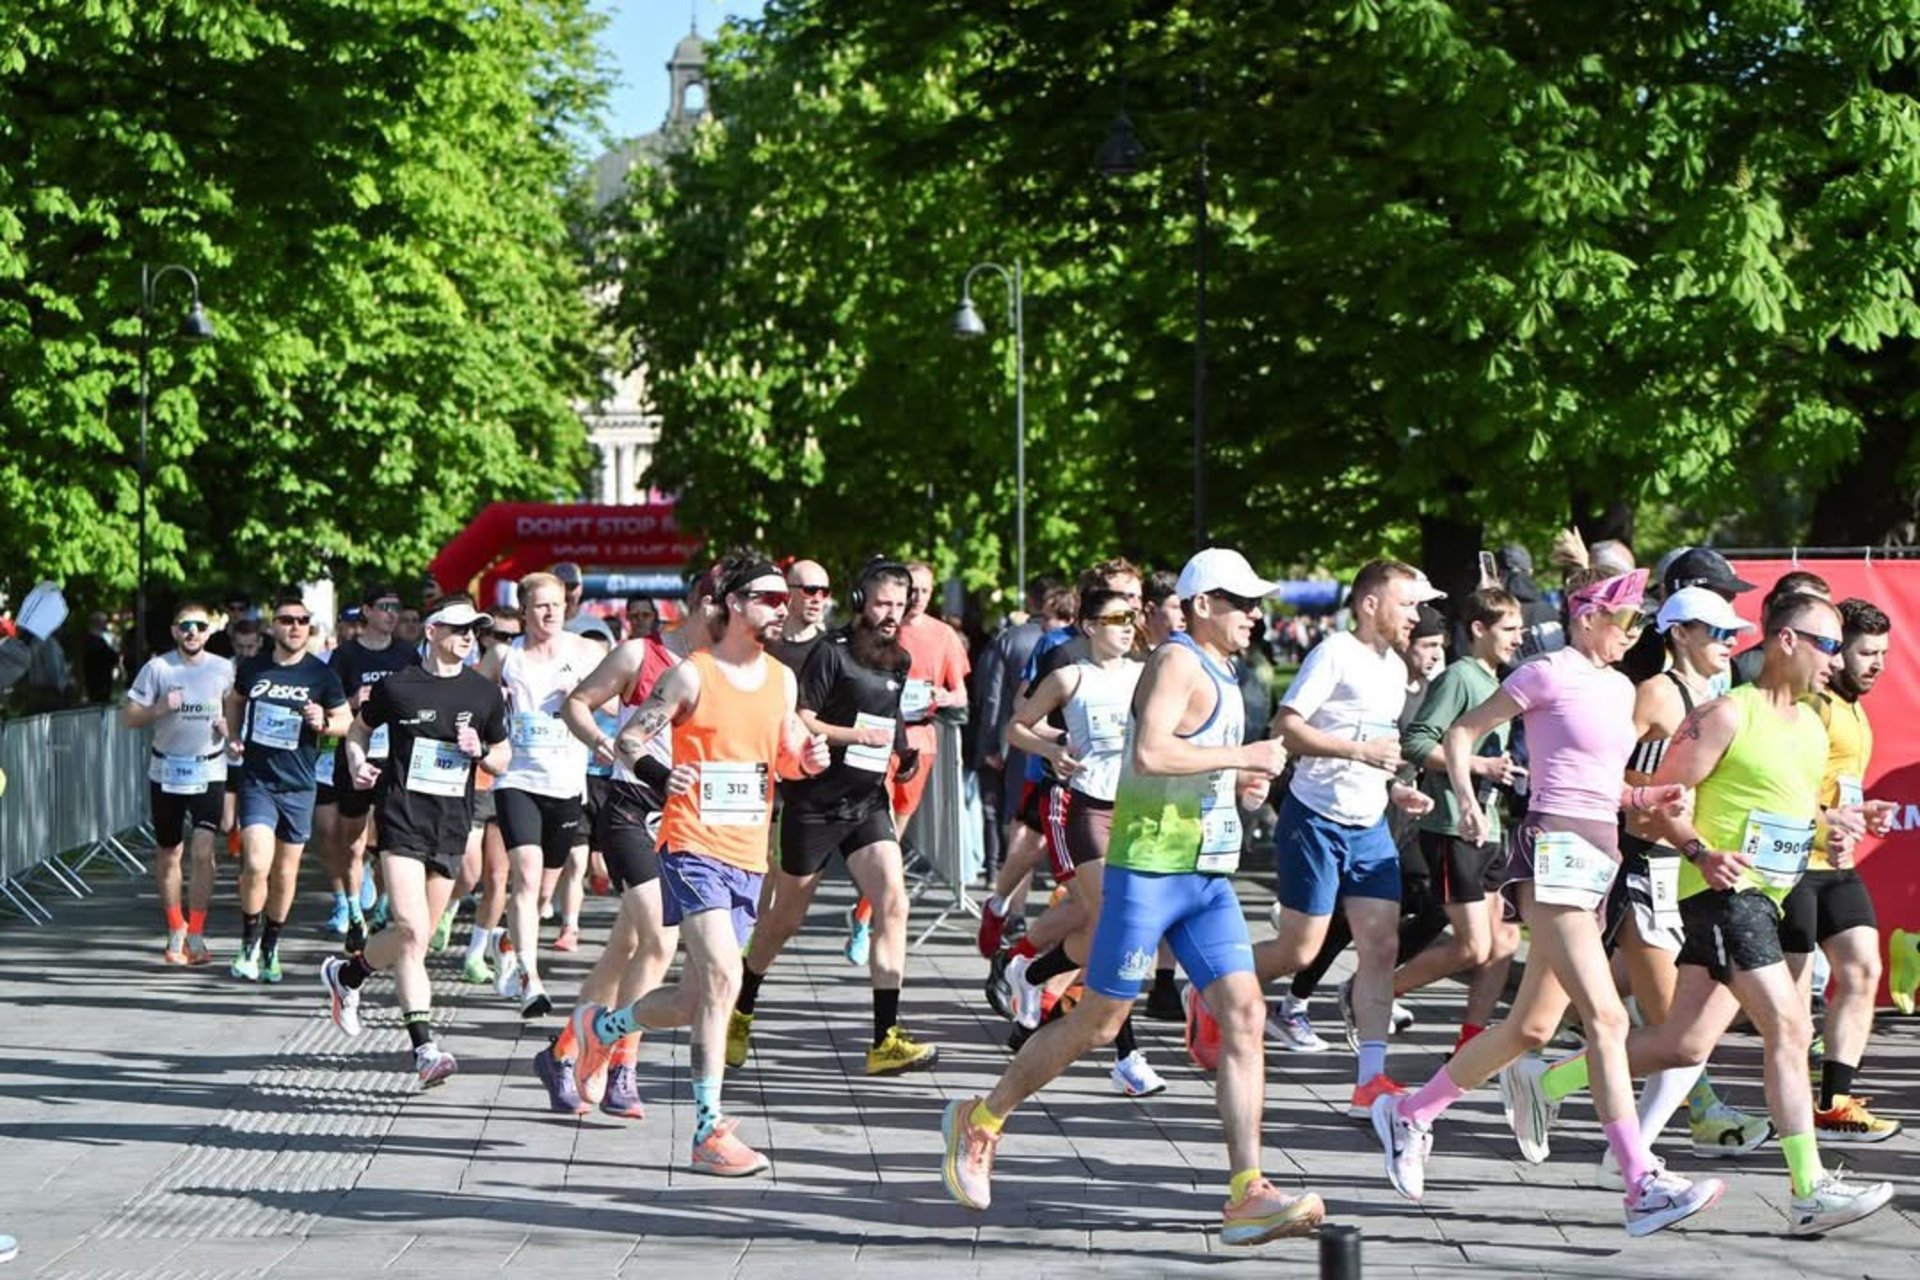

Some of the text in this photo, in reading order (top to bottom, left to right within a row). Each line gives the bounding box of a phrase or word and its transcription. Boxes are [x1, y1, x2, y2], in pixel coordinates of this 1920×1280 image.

[517, 517, 591, 536] DON'T
[597, 517, 656, 535] STOP
[727, 783, 749, 795] 312
[1824, 1120, 1869, 1133] NITRO
